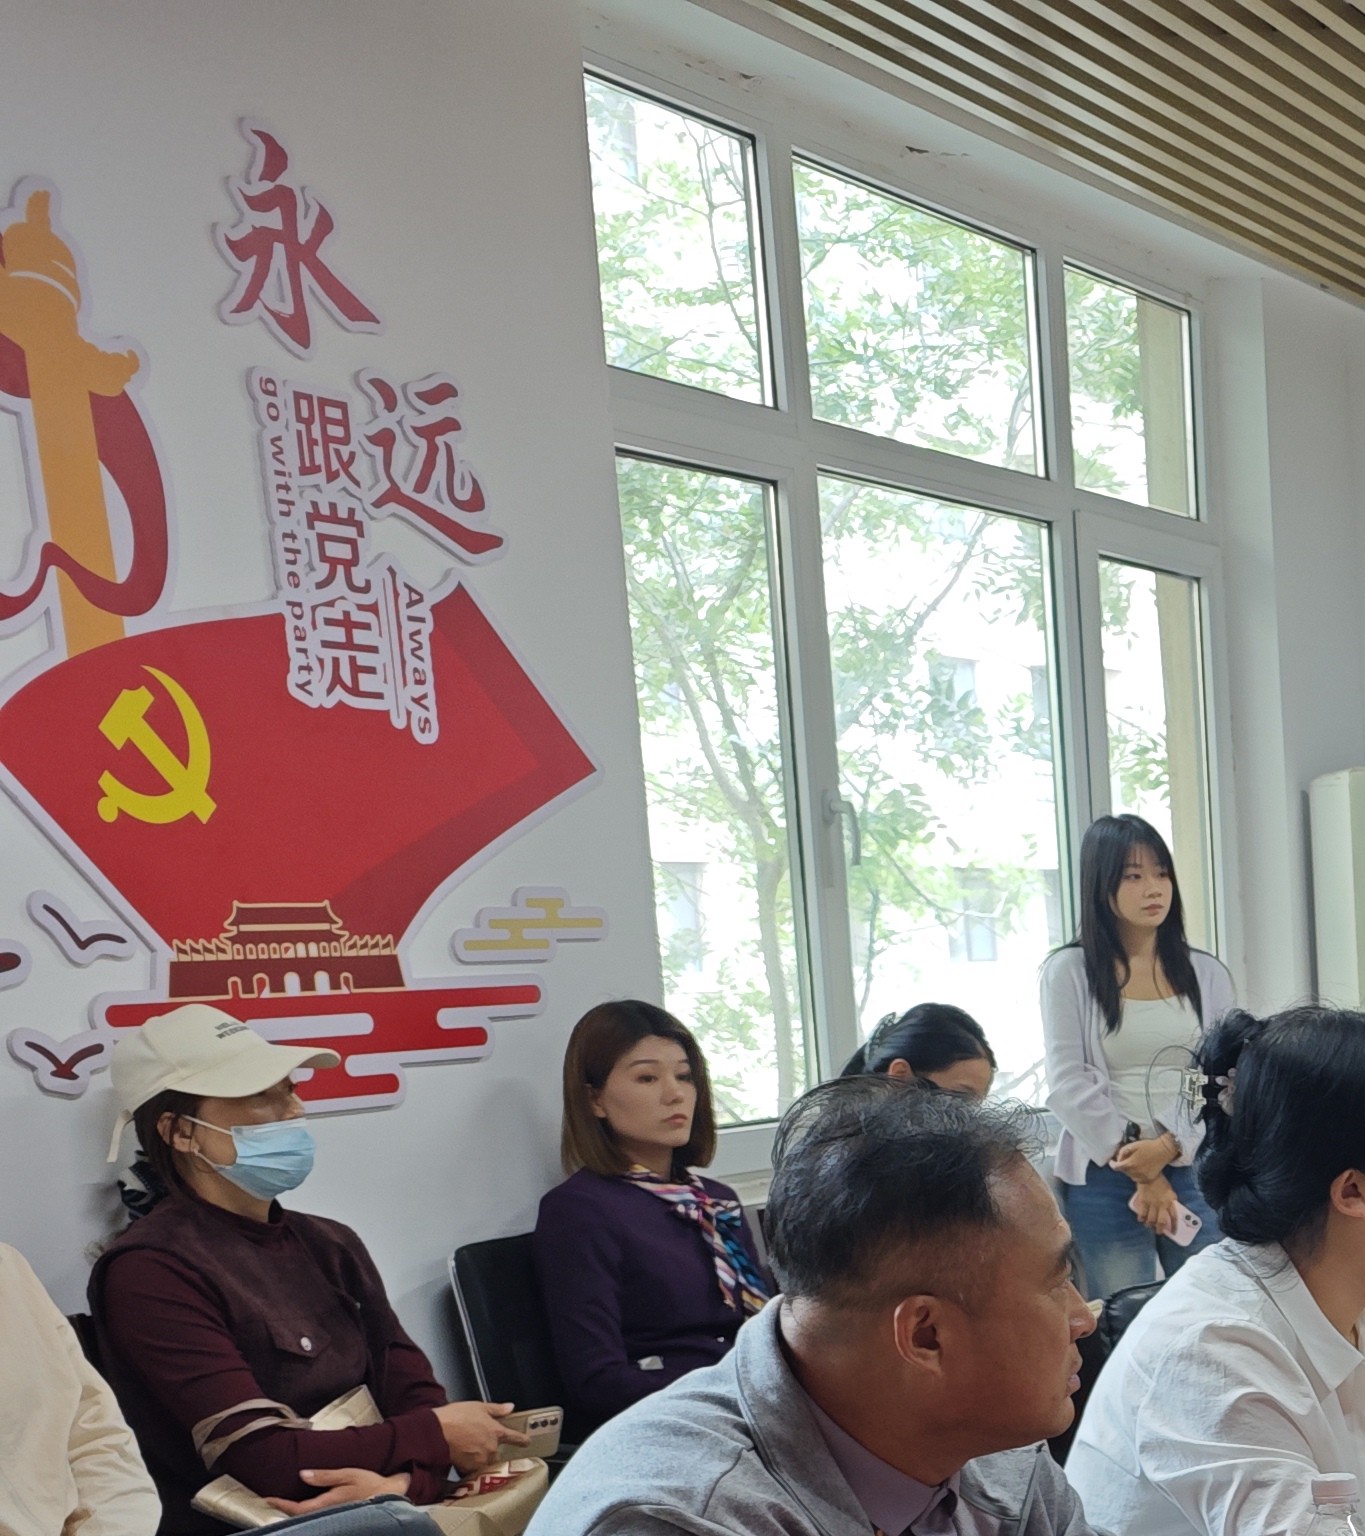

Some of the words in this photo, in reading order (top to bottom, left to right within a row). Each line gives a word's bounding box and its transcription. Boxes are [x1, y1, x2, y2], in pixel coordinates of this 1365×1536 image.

[259, 376, 281, 422] go
[270, 434, 296, 518] with
[281, 529, 302, 589] the
[293, 390, 386, 700] 跟党走
[286, 600, 316, 698] party
[402, 581, 433, 735] Always
